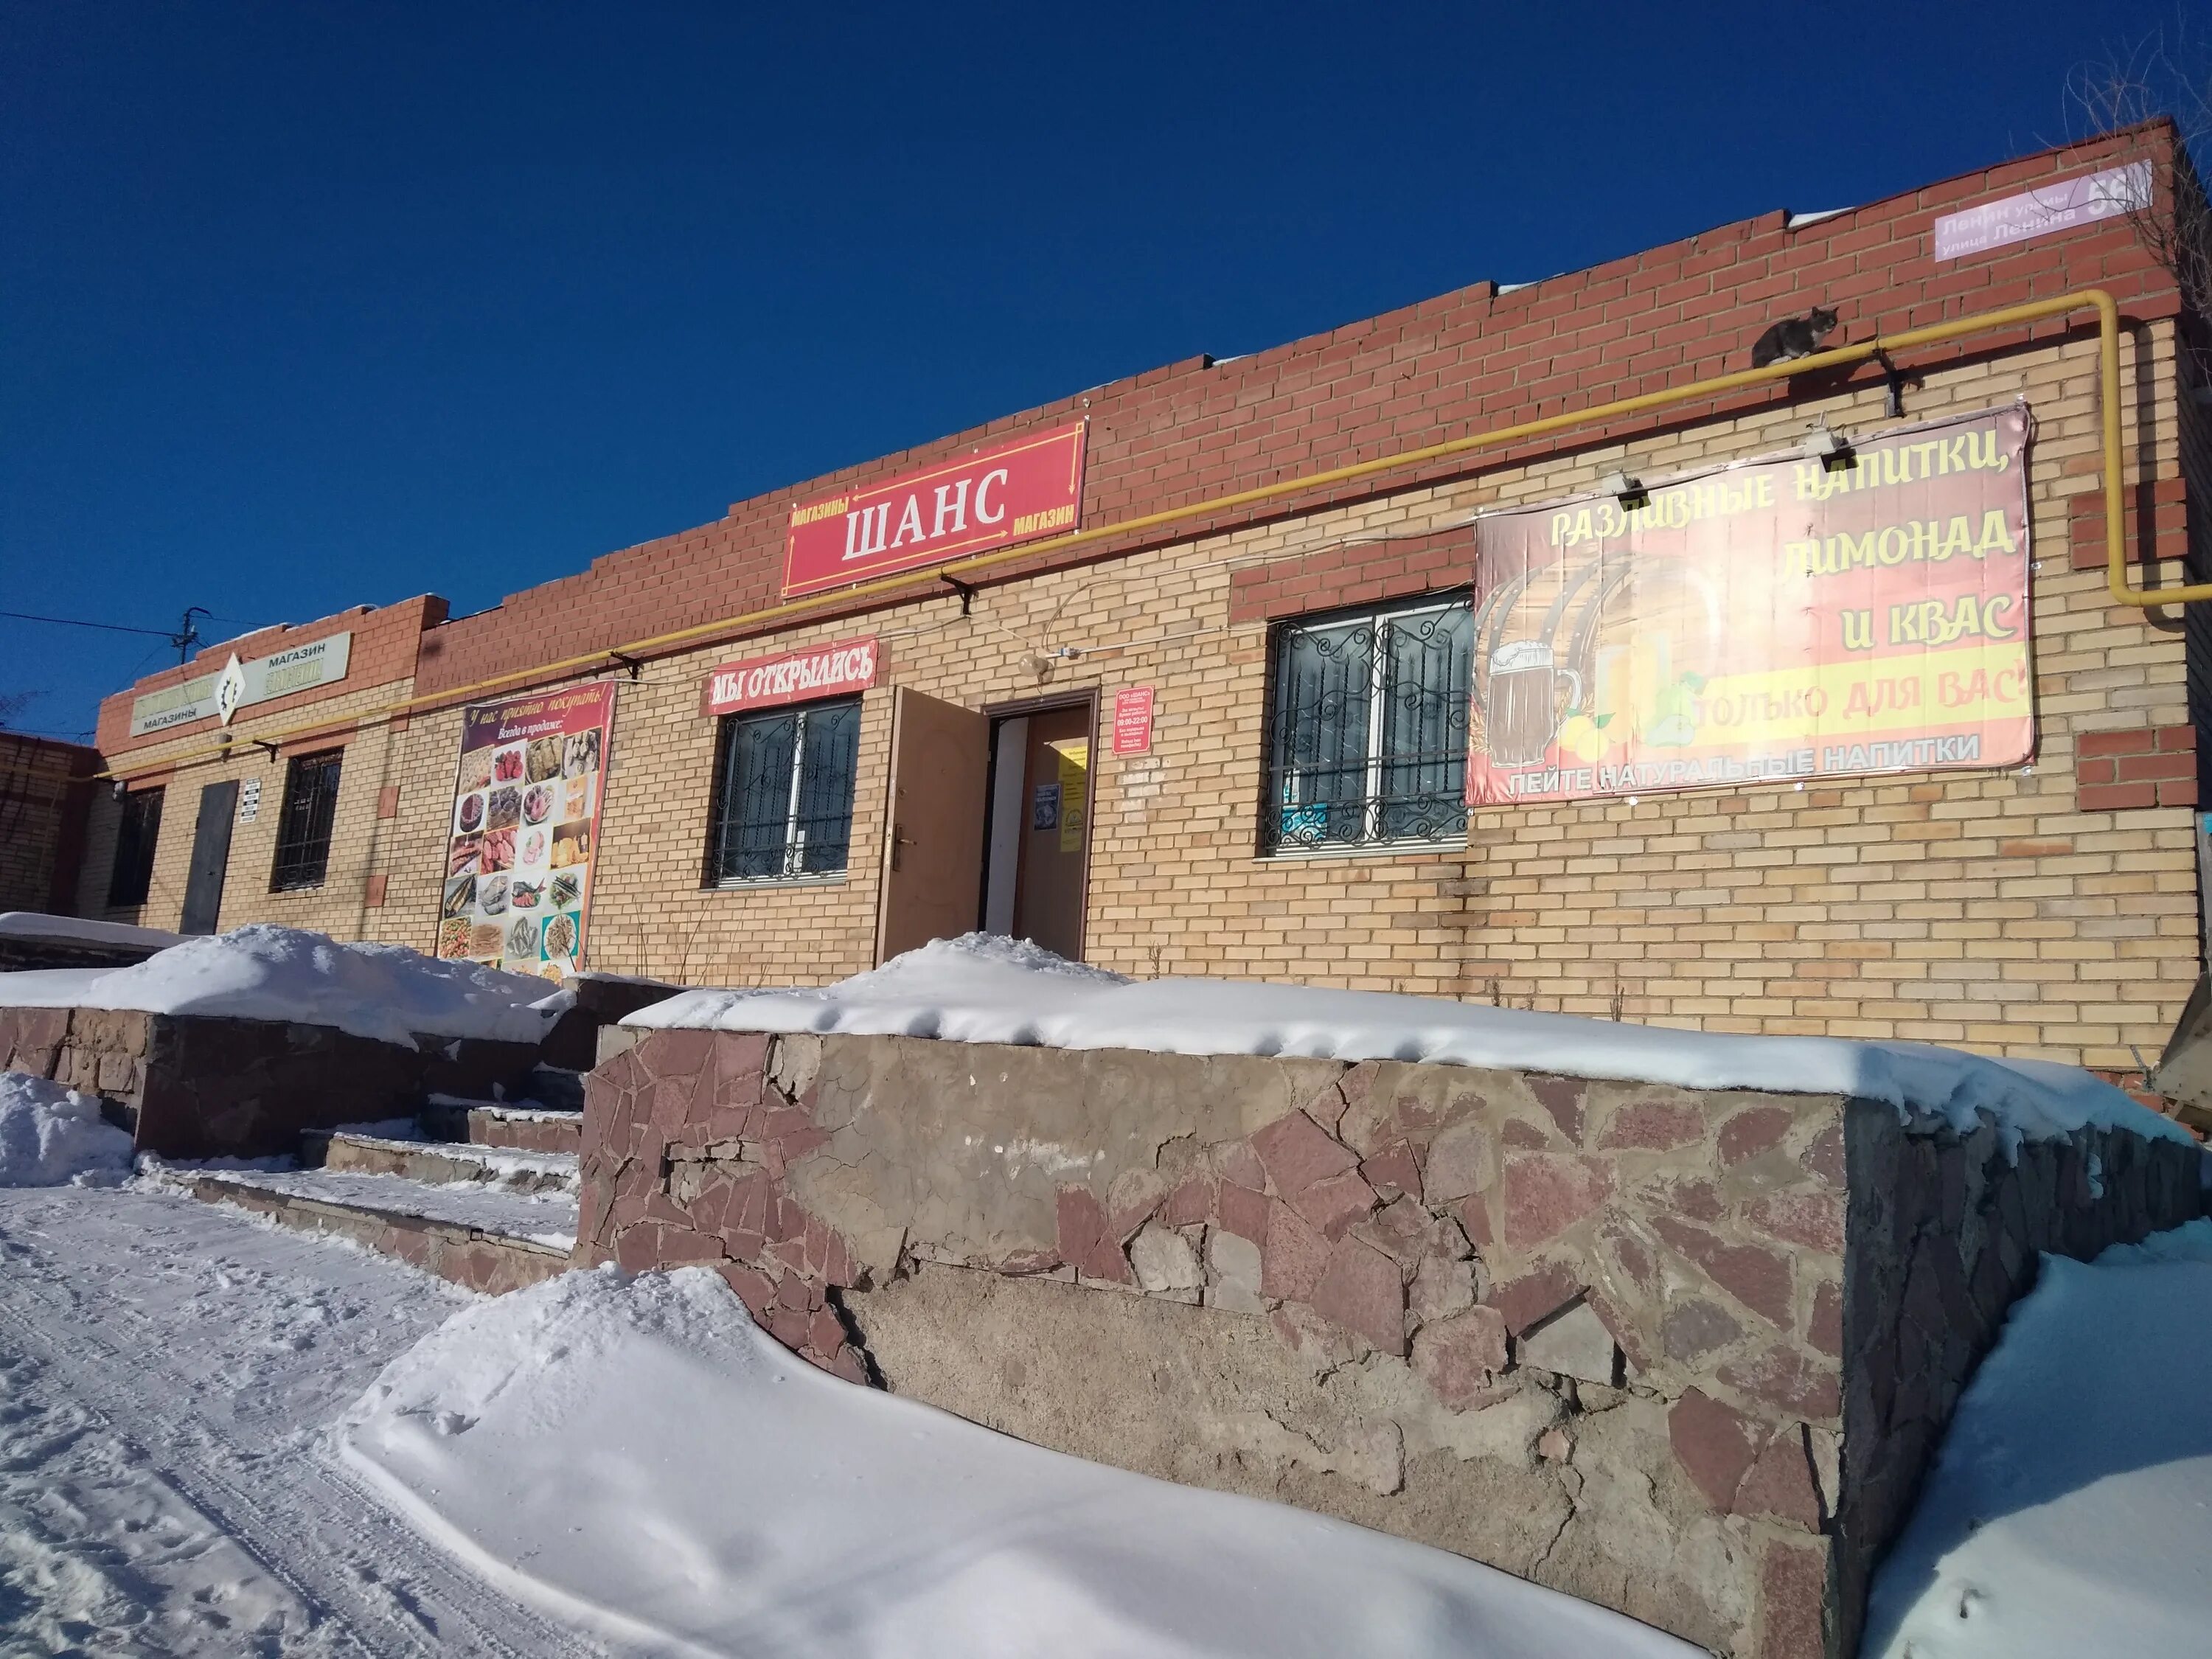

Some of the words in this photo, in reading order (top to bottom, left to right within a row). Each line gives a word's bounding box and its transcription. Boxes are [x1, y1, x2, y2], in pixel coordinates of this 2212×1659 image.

[1942, 208, 2009, 236] Ленин
[2015, 192, 2068, 219] урамы
[1942, 233, 1988, 257] улица
[1993, 208, 2076, 241] Ленина
[1551, 473, 1776, 546] РАЗЛИВНЫЕ
[1792, 429, 2009, 501] НАПИТКИ,
[791, 495, 849, 528] МАГАЗИНЫ
[841, 468, 1009, 562] ШАНС
[1013, 504, 1075, 538] МАГАЗИН
[1782, 509, 2017, 580] ЛИМОНАД
[1891, 595, 2017, 645] КВАС
[268, 642, 326, 668] МАГАЗИН
[711, 670, 745, 706] МЫ
[748, 646, 874, 698] ОТКРЫЛИСЬ
[469, 709, 480, 727] У
[480, 710, 498, 725] нас
[501, 700, 545, 729] приятно
[548, 688, 605, 717] покупать!
[1691, 684, 1829, 728] ТОЛЬКО
[1842, 675, 1921, 720] ДЛЯ
[1938, 658, 2027, 708] ВАС!
[143, 707, 197, 730] МАГАЗИНЫ
[497, 726, 522, 740] Всегда
[521, 727, 526, 735] в
[526, 719, 564, 737] продаже:
[1117, 716, 1148, 726] 09:00-22:00
[1509, 765, 1593, 796] ПЕЙТЕ
[1600, 749, 1815, 790] НАТУРАЛЬНЫЕ
[1823, 734, 1980, 772] НАПИТКИ
